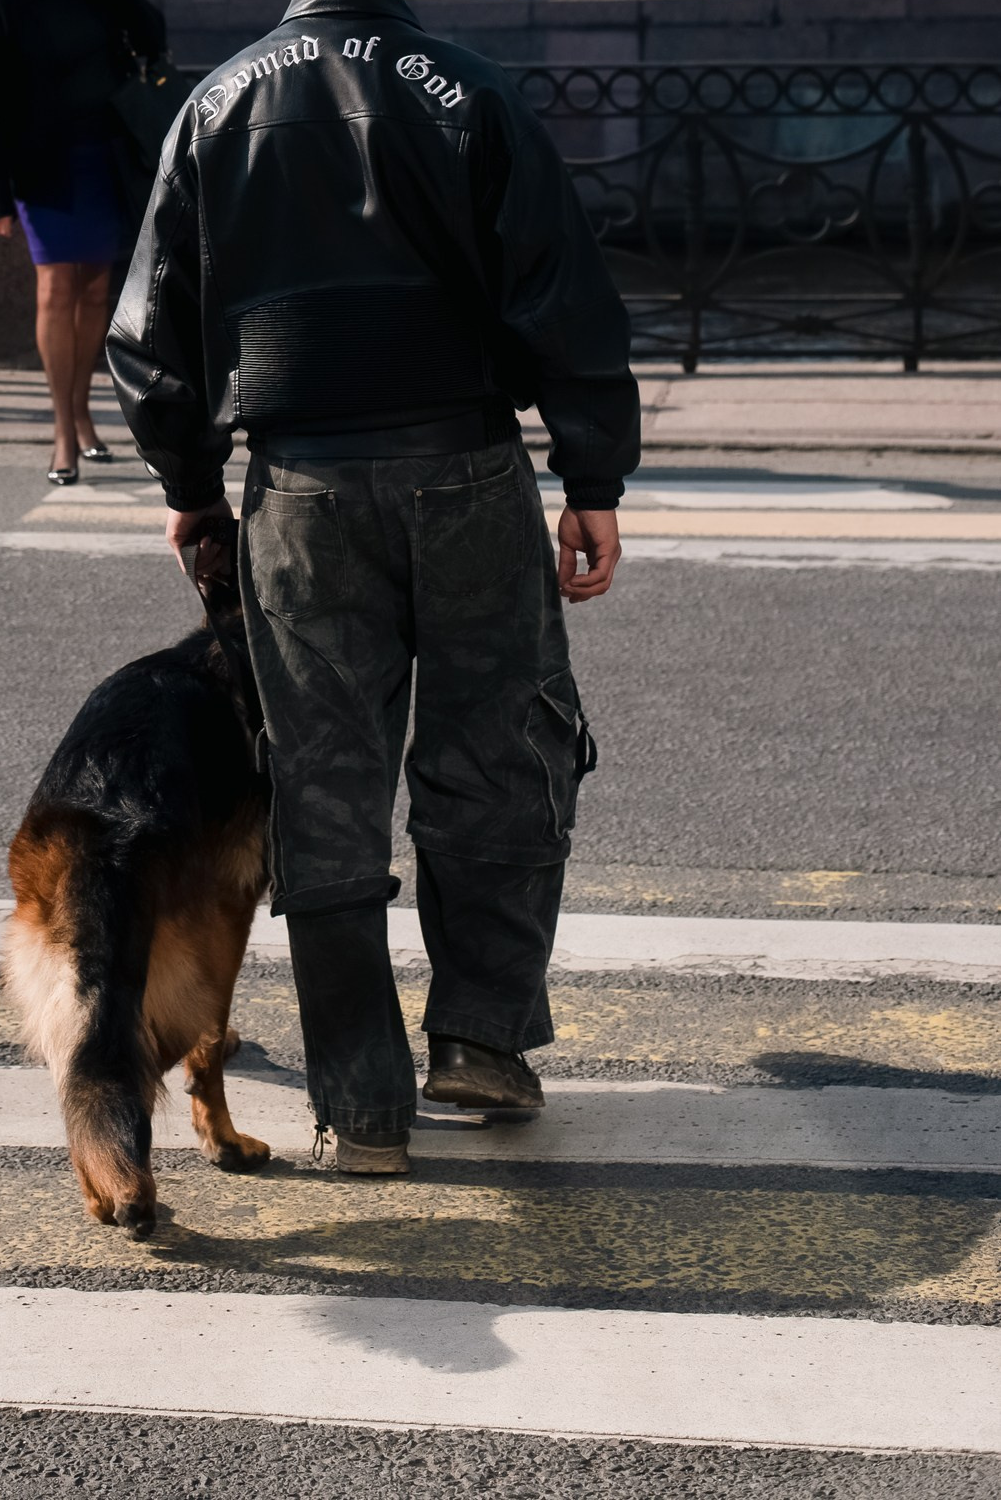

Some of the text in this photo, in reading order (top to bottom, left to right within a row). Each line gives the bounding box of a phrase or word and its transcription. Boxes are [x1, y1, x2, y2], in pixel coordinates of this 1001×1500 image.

[198, 35, 467, 126] Nomad of God
